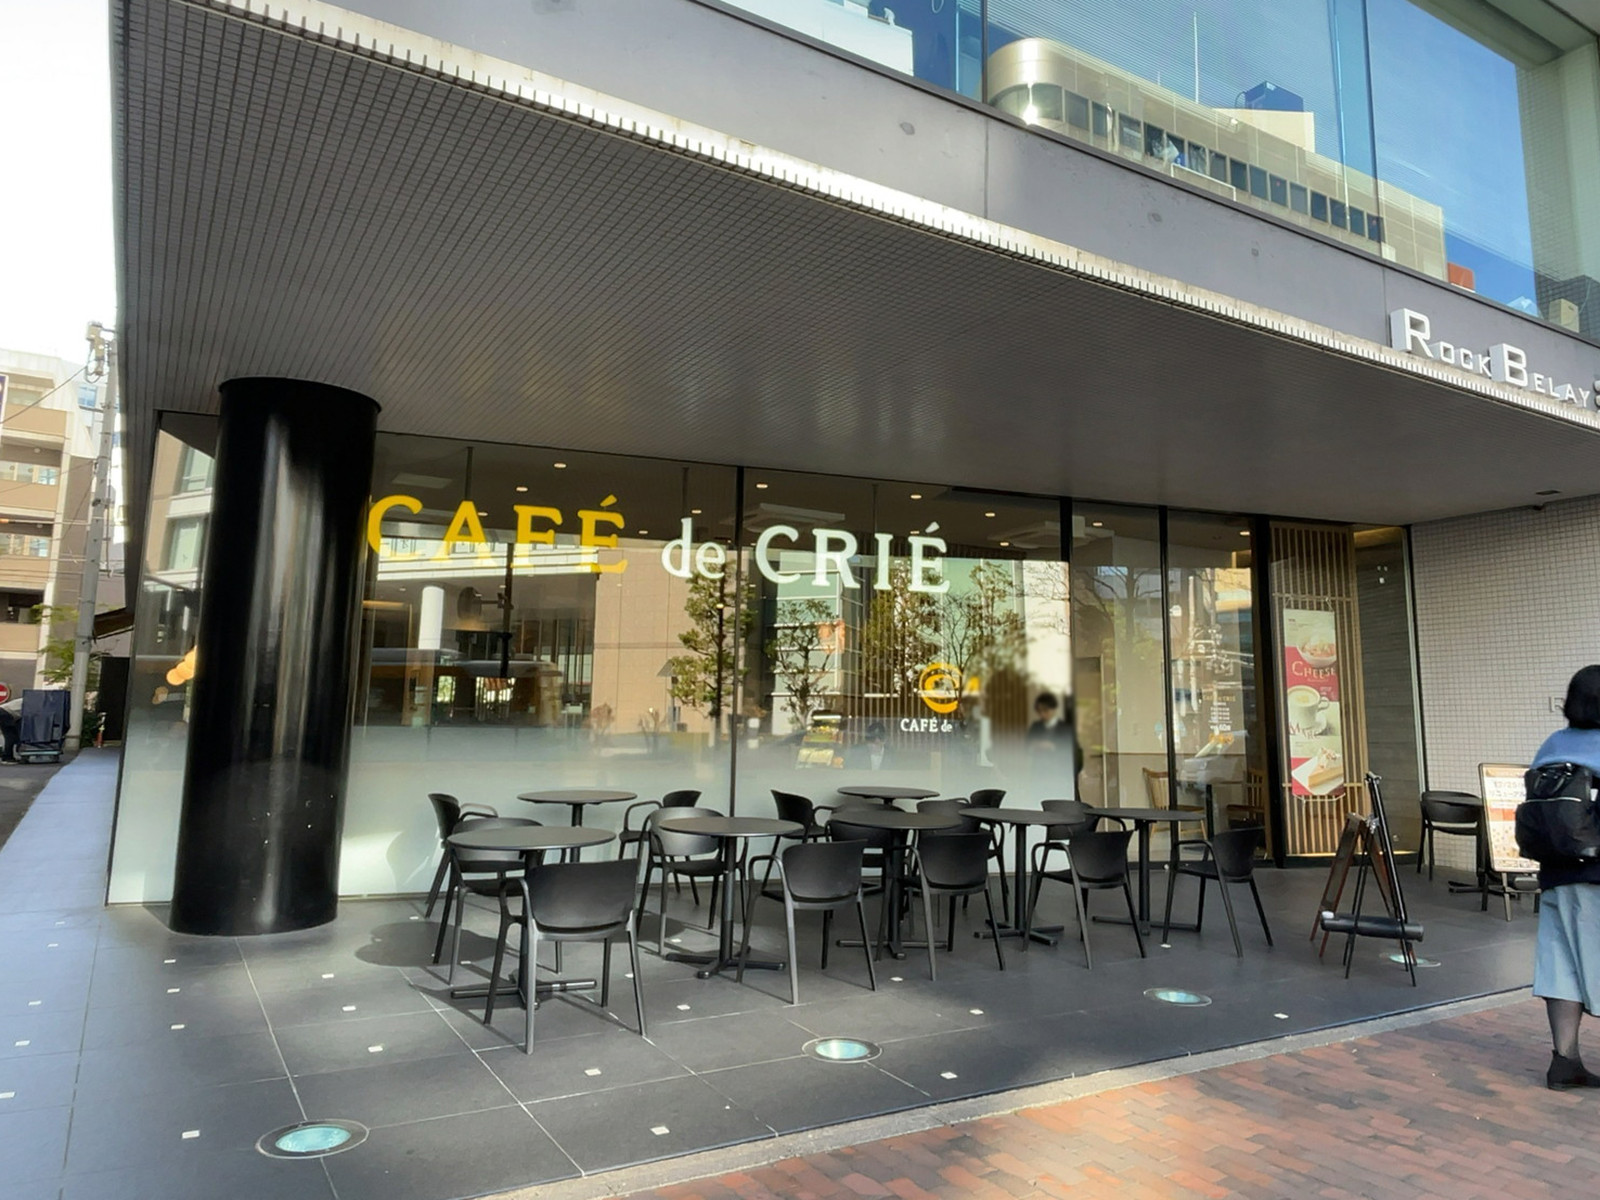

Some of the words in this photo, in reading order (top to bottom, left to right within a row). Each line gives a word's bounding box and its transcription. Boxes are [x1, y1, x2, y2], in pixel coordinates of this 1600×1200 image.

[1391, 308, 1491, 377] ROCK
[367, 494, 628, 573] CAFÉ
[661, 517, 726, 579] de
[755, 521, 951, 593] CRIÉ
[900, 716, 938, 732] CAFÉ
[940, 719, 953, 732] de
